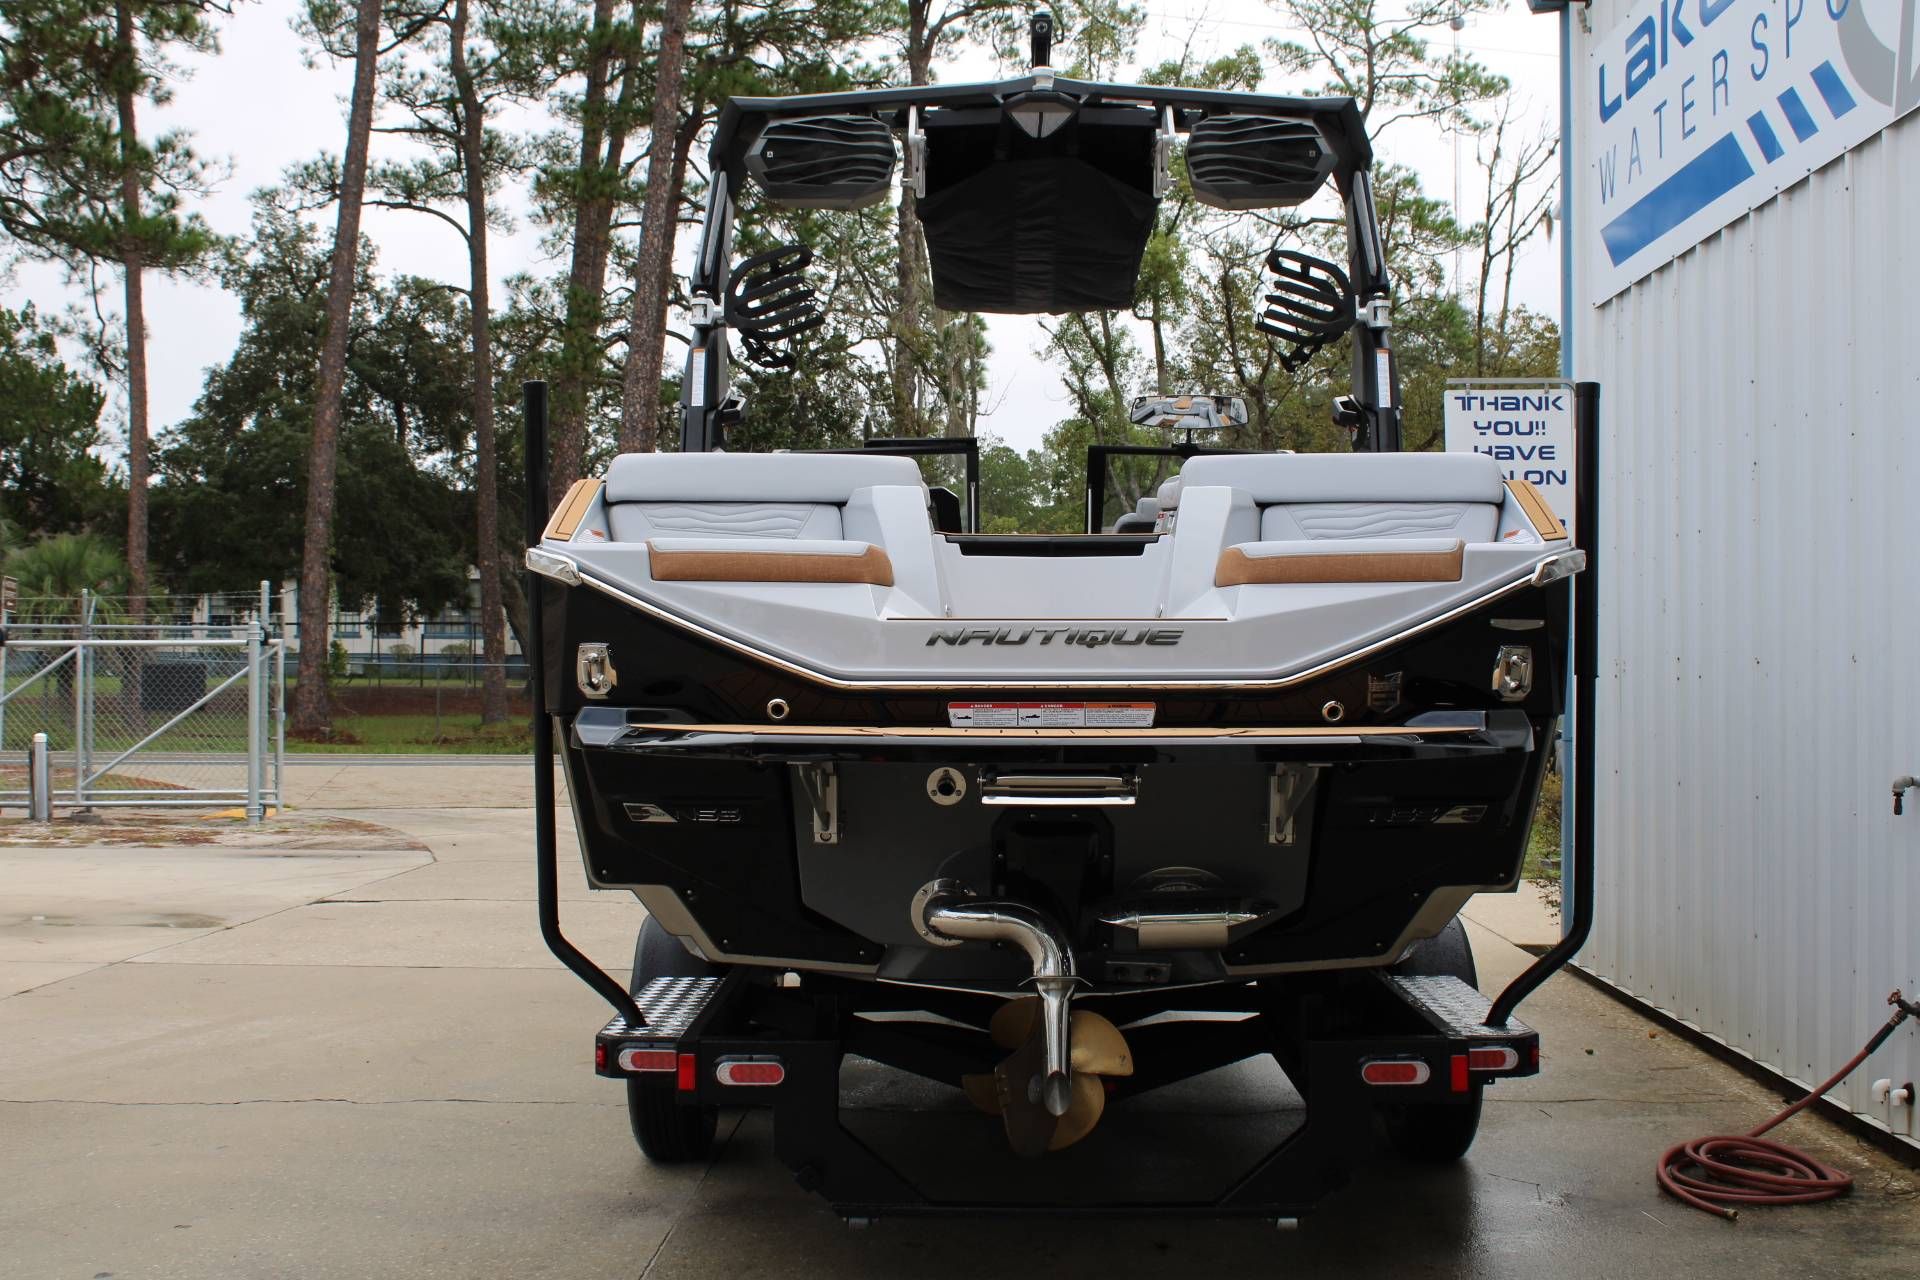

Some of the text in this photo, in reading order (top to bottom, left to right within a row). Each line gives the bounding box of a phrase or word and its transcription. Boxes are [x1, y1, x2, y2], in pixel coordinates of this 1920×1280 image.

[1599, 0, 1849, 205] WATERSP
[1473, 420, 1546, 436] YOU!!
[925, 625, 1185, 648] NAUTIQUE
